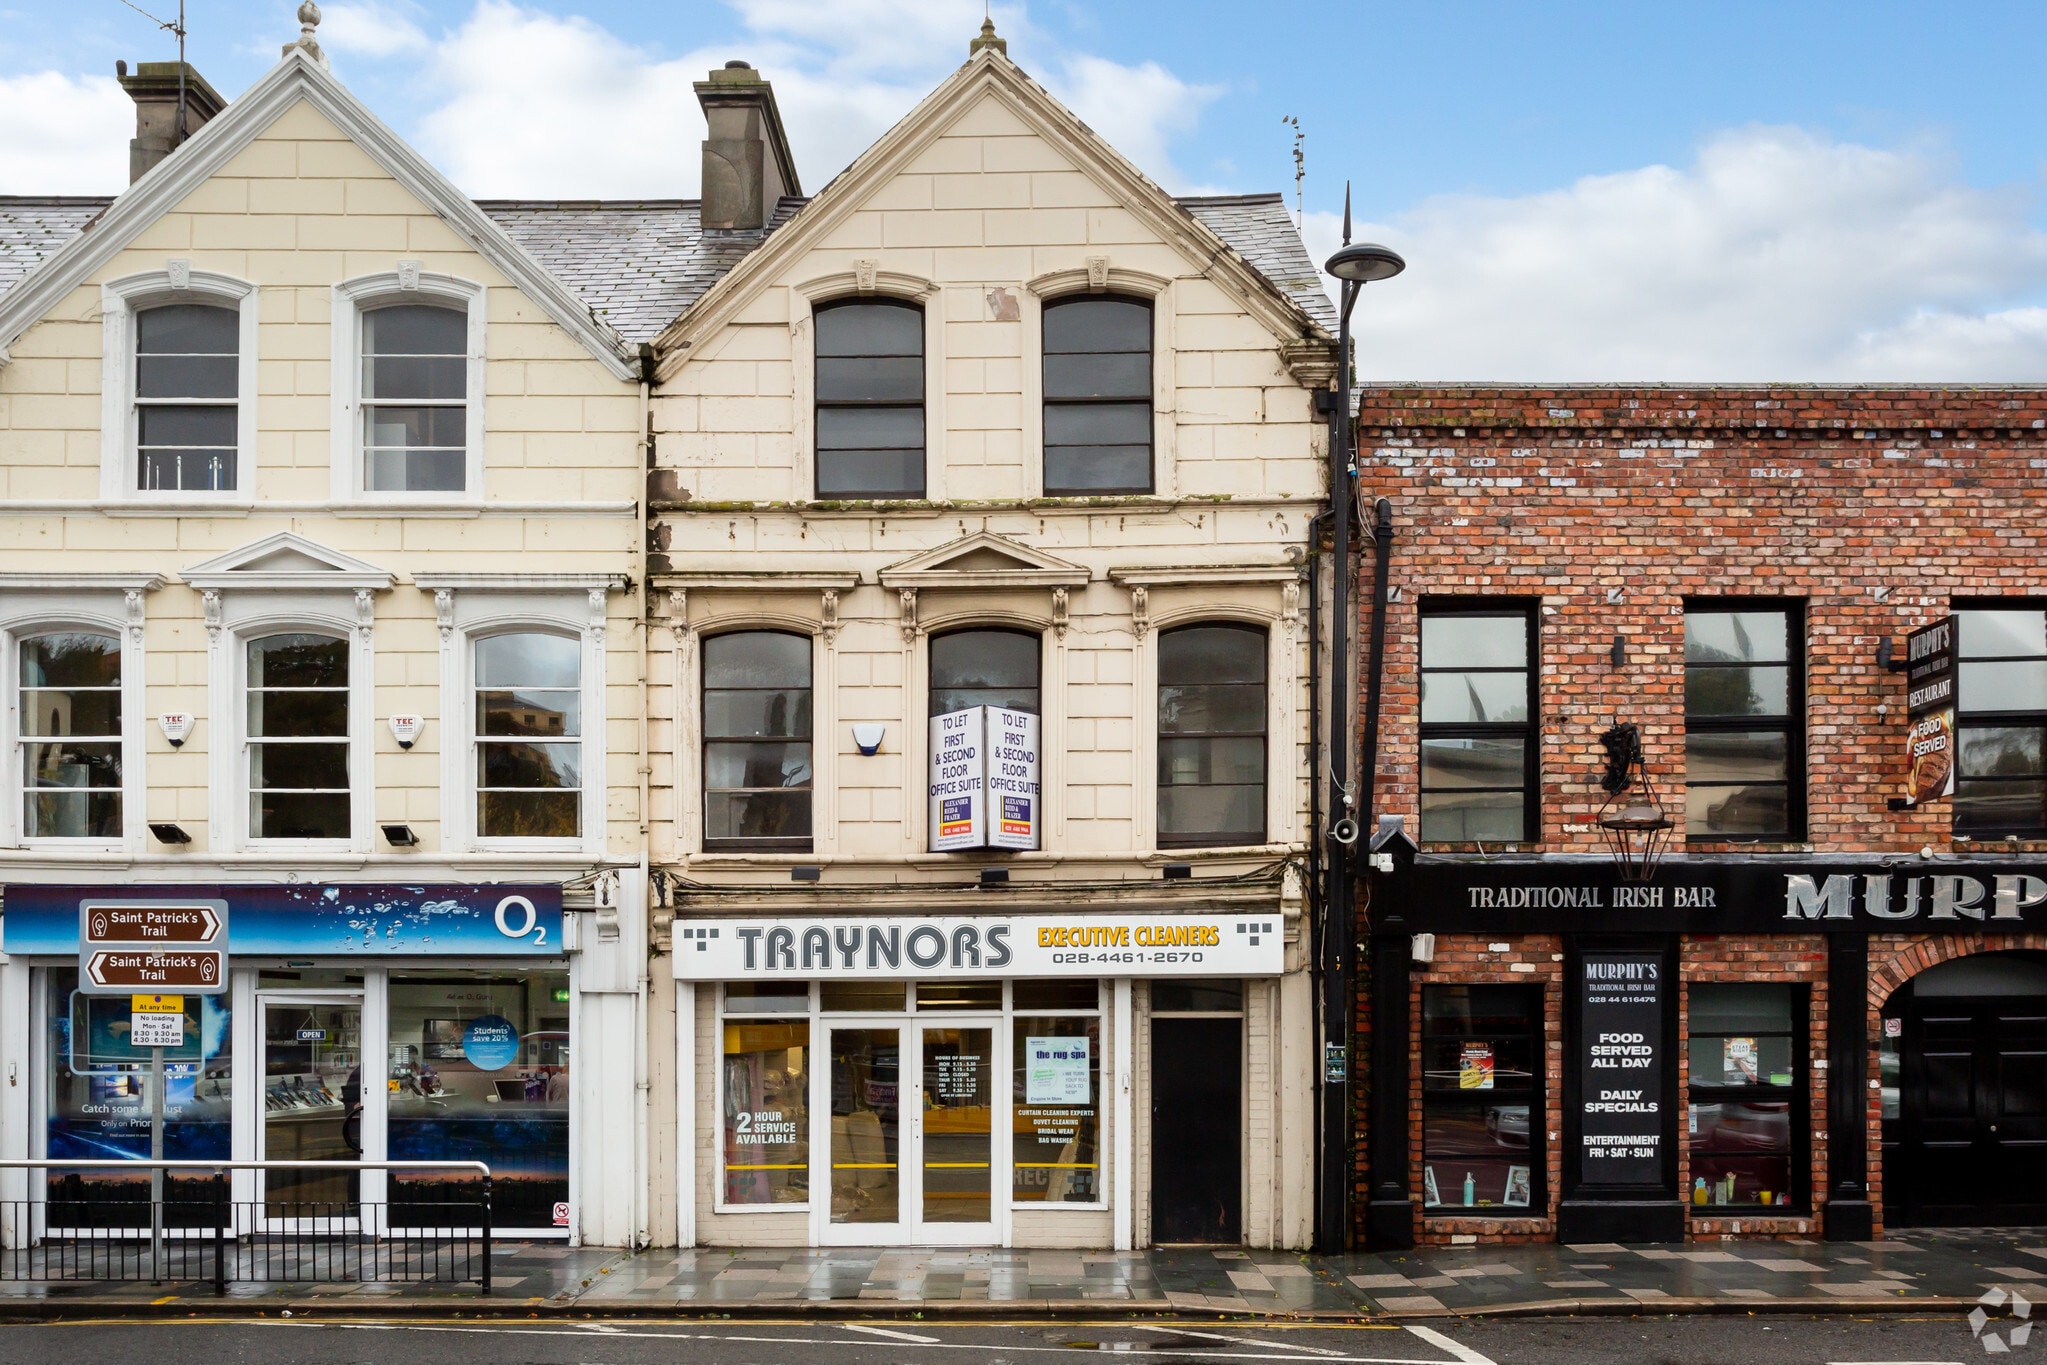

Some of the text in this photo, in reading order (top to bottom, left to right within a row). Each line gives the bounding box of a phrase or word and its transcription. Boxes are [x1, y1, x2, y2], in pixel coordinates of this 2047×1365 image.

[1910, 623, 1949, 661] MURPHY'S
[1909, 680, 1951, 708] RESTAURANT
[943, 714, 968, 730] TO LET
[1002, 713, 1028, 728] TO LET
[1918, 718, 1941, 737] FOOD
[944, 733, 965, 748] FIRST
[1004, 732, 1024, 746] FIRST
[1913, 735, 1946, 757] SERVED
[936, 747, 976, 765] & SECOND
[995, 746, 1034, 763] & SECOND
[942, 764, 968, 779] FLOOR
[1002, 763, 1028, 778] FLOOR
[930, 778, 980, 796] OFFICE SUITE
[990, 777, 1040, 794] OFFICE SUITE
[1468, 887, 1716, 908] TRADITIONAL IRISH BAR
[1782, 873, 2047, 920] MURP
[111, 912, 198, 924] Saint Patrick's
[141, 925, 168, 936] Trail
[1038, 926, 1220, 947] EXECUTIVE CLEANERS
[736, 924, 1013, 970] TRAYNORS
[110, 956, 196, 967] Saint Patrick's
[1052, 952, 1204, 964] 028-4461-2670
[140, 970, 166, 980] Trail
[1586, 963, 1658, 979] MURPHY'S
[1589, 984, 1656, 992] TRADITIONAL IRISH BAR
[474, 1026, 508, 1035] Students
[492, 1034, 508, 1042] 20%
[1600, 1033, 1644, 1043] FOOD
[1036, 1050, 1086, 1060] the rug spa
[1590, 1046, 1652, 1056] SERVED
[1591, 1058, 1652, 1068] ALL DAY
[1600, 1090, 1642, 1100] DAILY
[82, 1104, 109, 1114] Catch
[112, 1106, 138, 1114] some
[1584, 1102, 1658, 1112] SPECIALS
[101, 1120, 116, 1129] Only
[130, 1119, 163, 1128] Prior
[736, 1112, 782, 1133] 2 HOUR
[754, 1123, 796, 1133] SERVICE
[736, 1134, 796, 1144] AVAILABLE
[1584, 1136, 1660, 1145] ENTERTAINMENT
[1590, 1148, 1654, 1158] FRI SAT SUN
